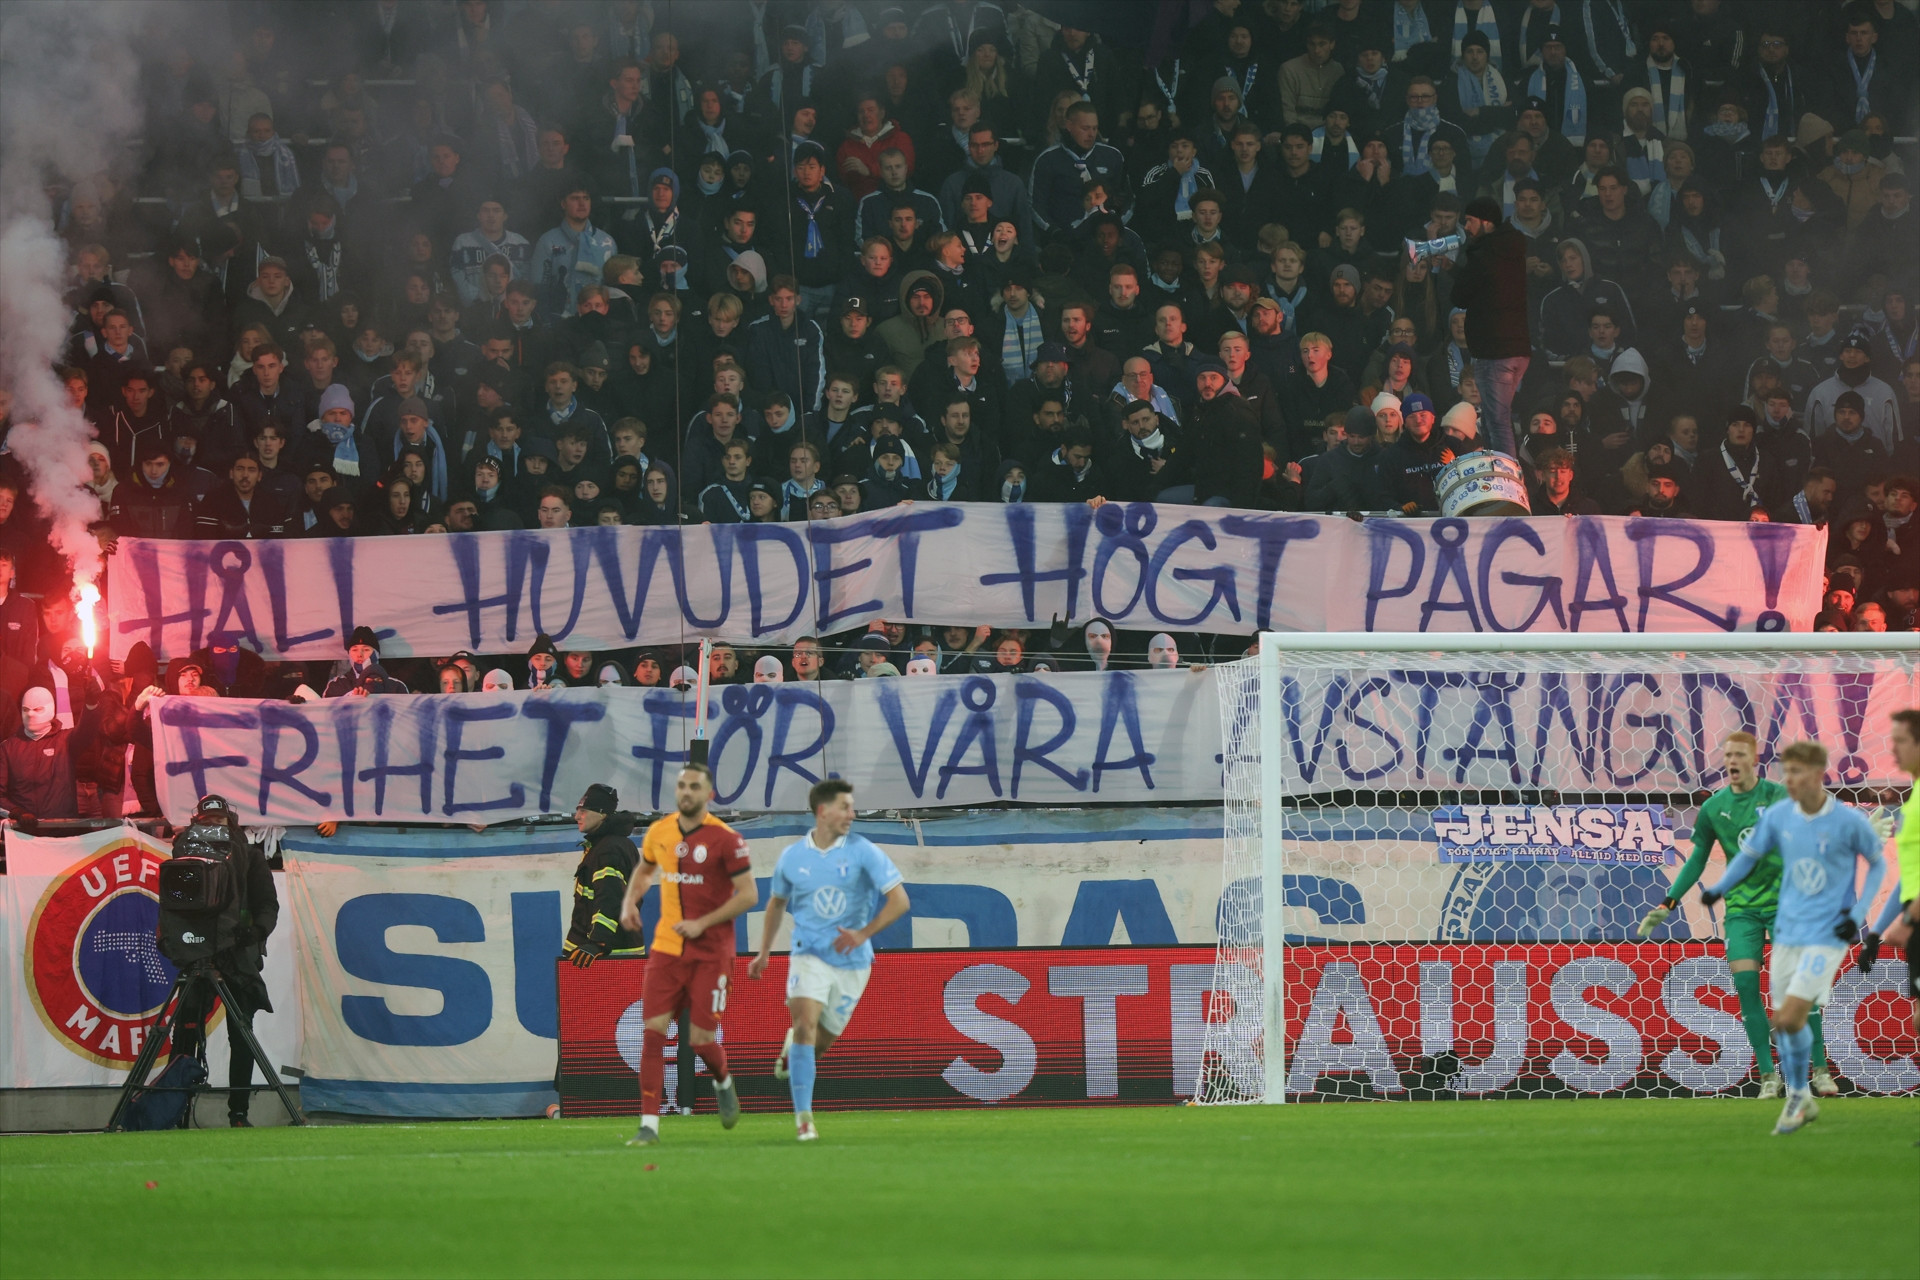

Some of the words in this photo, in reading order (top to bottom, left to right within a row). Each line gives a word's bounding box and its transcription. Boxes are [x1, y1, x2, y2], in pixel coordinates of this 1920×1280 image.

[118, 537, 396, 658] HÅLL
[432, 507, 965, 650] HUVUDET
[980, 501, 1320, 630] HÖGT
[160, 697, 605, 817] FRIHET
[632, 683, 839, 810] FÖR
[873, 671, 1157, 799] VÅRA
[1436, 806, 1674, 852] JENSA
[80, 853, 160, 898] UEF
[667, 872, 704, 885] SOCAR
[1616, 852, 1641, 862] MED
[1644, 854, 1665, 863] OSS
[711, 989, 728, 1013] 18
[65, 1003, 174, 1056] MAF
